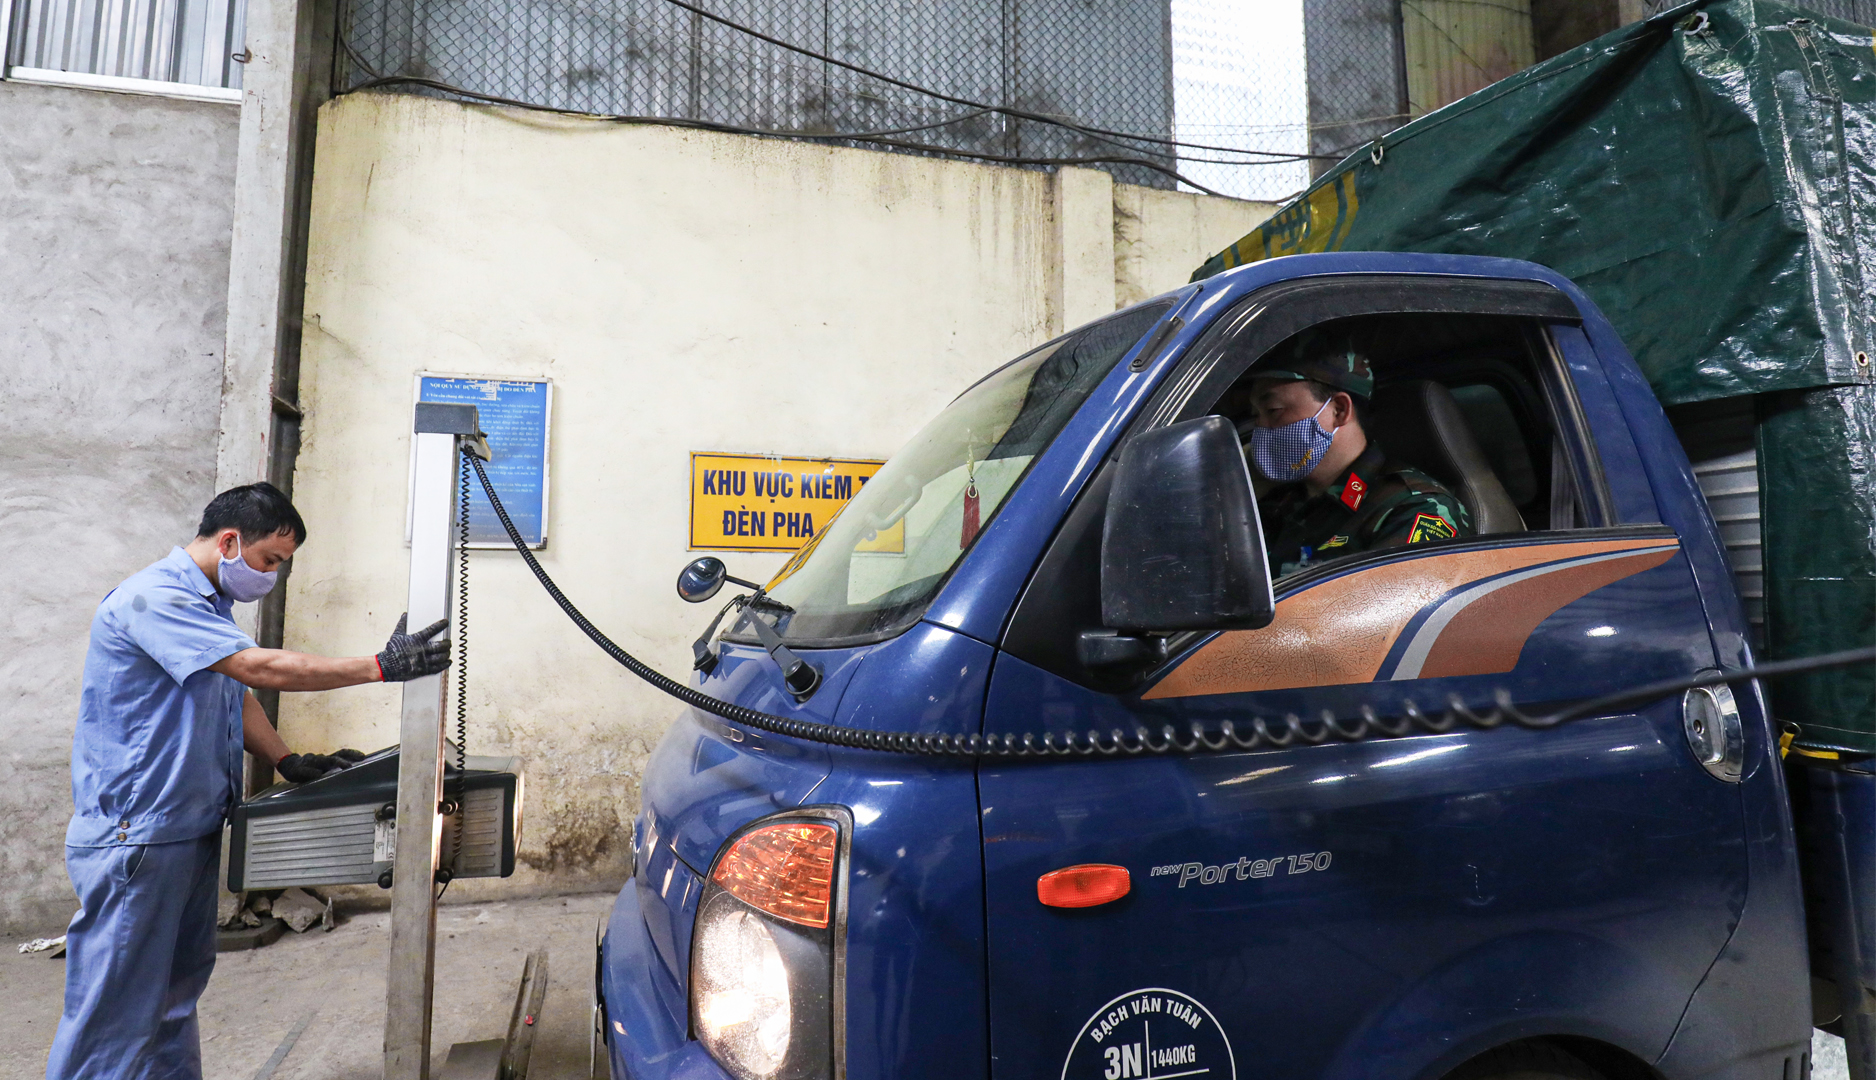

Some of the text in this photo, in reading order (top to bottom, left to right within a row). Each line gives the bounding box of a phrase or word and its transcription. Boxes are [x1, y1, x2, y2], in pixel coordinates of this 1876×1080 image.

[703, 464, 852, 503] KHU VỰC KIỂM
[722, 505, 814, 538] ĐÈN PHA
[1150, 851, 1332, 888] new Porter 150
[1090, 1006, 1130, 1043] BẠCH
[1130, 995, 1162, 1015] VĂN
[1104, 1042, 1196, 1080] 3N 1440KG
